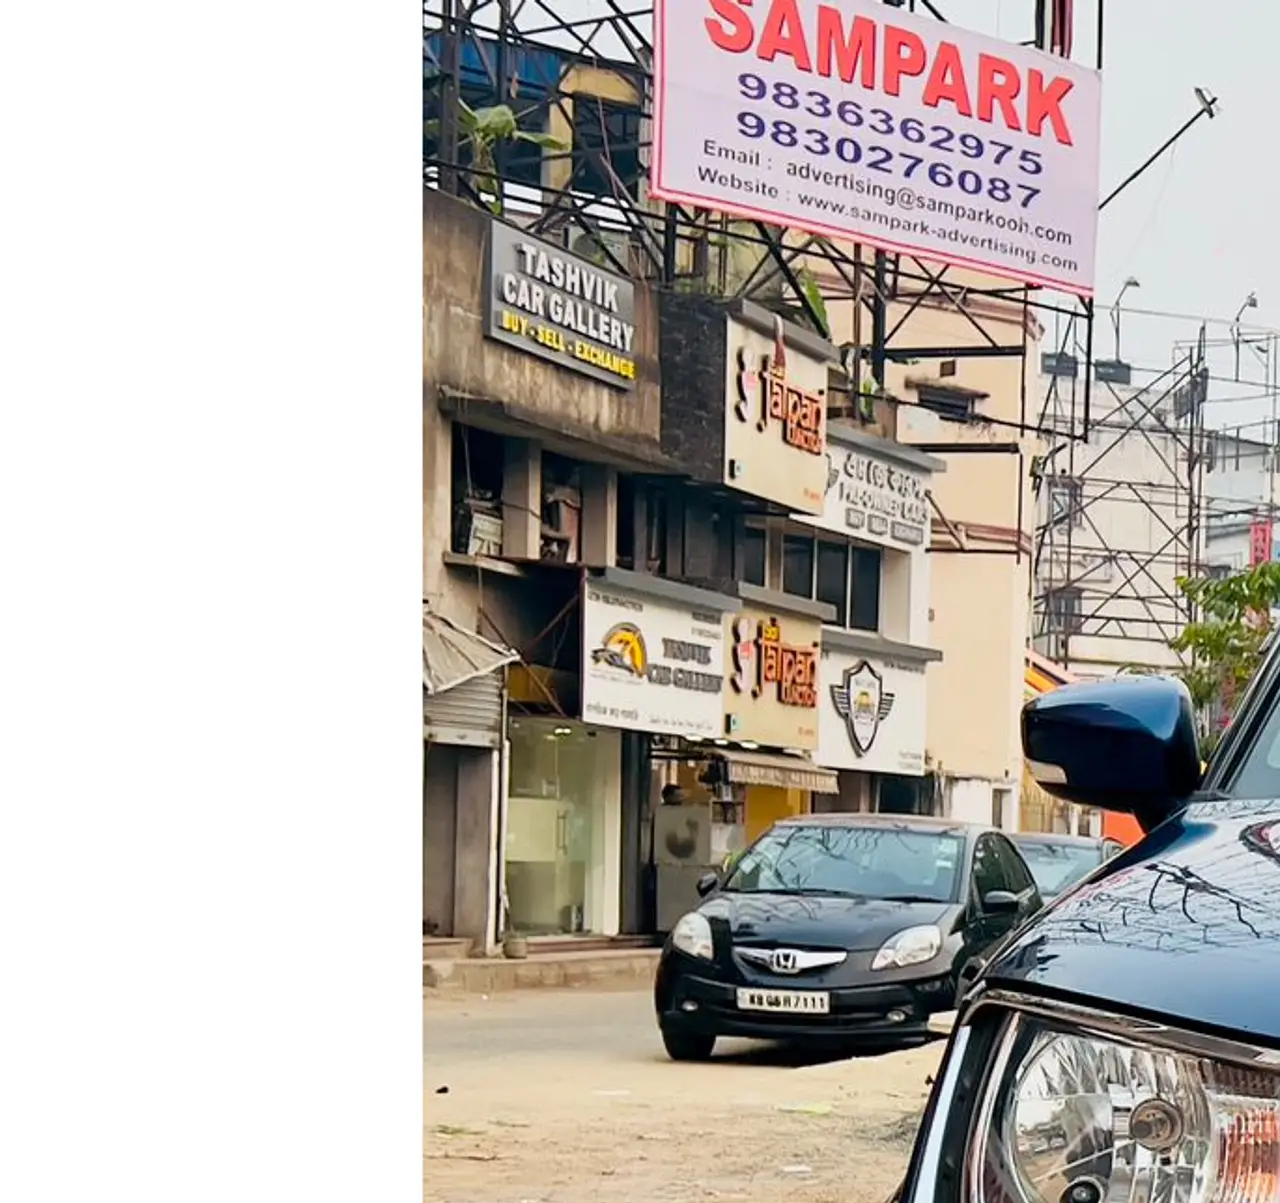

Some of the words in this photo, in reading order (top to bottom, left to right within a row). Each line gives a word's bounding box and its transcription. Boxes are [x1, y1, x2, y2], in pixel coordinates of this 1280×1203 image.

[704, 0, 1075, 147] SAMPARK
[702, 139, 761, 169] Email
[736, 110, 1041, 210] 9830276087
[737, 72, 1043, 176] 9836362975
[697, 165, 779, 200] Website
[798, 191, 1079, 273] www.sampark-advertising.com
[502, 272, 545, 317] CAR
[549, 292, 634, 353] GALLERY
[519, 241, 619, 313] TASHVIK
[501, 310, 529, 337] BUY
[537, 324, 566, 352] SELL
[575, 340, 636, 380] EXCHANGE
